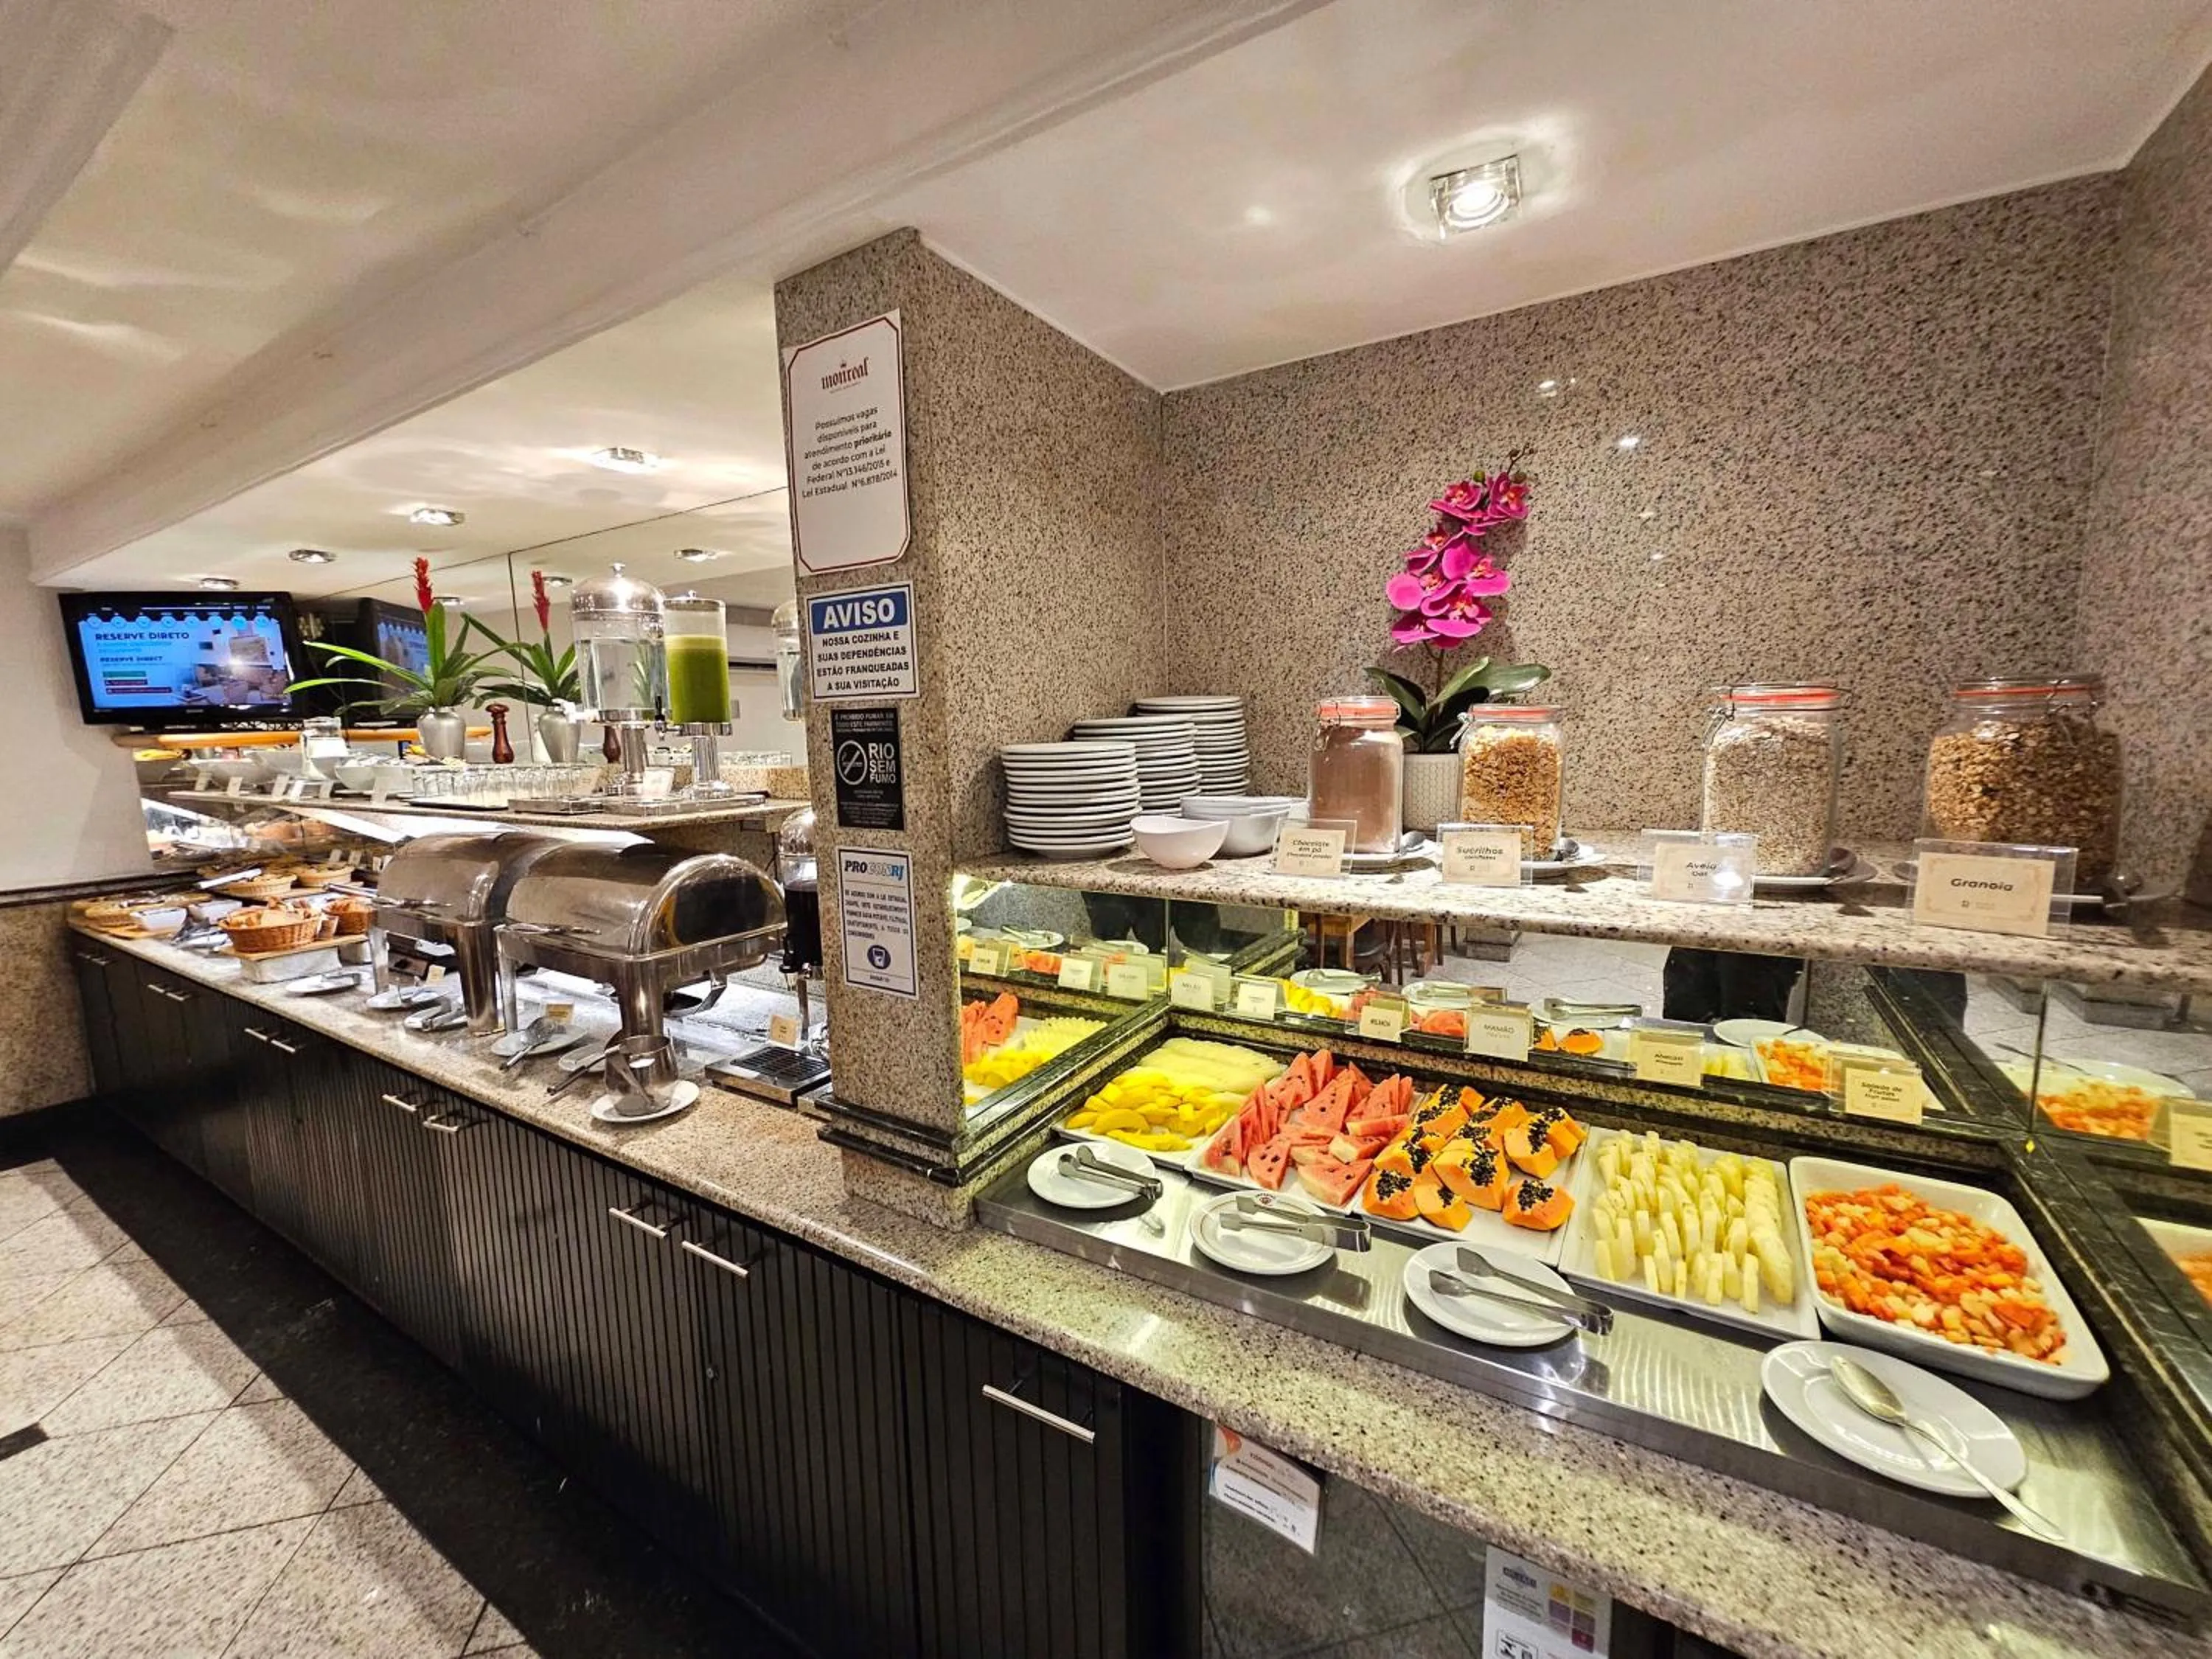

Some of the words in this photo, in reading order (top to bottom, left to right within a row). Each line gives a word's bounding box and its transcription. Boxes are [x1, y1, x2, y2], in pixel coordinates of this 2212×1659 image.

[856, 406, 877, 420] vagas
[860, 421, 877, 433] para
[804, 441, 853, 459] atendimento
[853, 429, 891, 450] prioritário
[812, 462, 822, 471] de
[823, 455, 849, 468] acordo
[851, 451, 867, 462] com
[875, 444, 886, 456] Lei
[807, 470, 835, 484] Federal
[886, 459, 890, 467] e
[802, 486, 813, 498] Lei
[815, 481, 847, 496] Estadual
[824, 598, 895, 629] AVISO
[95, 632, 145, 640] RESERVE
[822, 637, 849, 647] NOSSA
[852, 633, 891, 644] COZINHA
[893, 631, 900, 640] E
[818, 653, 838, 662] SUAS
[841, 646, 906, 660] DEPENDÊNCIAS
[817, 666, 843, 677] ESTÃO
[846, 662, 909, 675] FRANQUEADAS
[827, 682, 833, 691] A
[835, 681, 852, 691] SUA
[853, 677, 900, 689] VISITAÇÃO
[868, 742, 894, 759] RIO
[869, 760, 896, 773] SEM
[869, 774, 897, 784] FUMO
[1456, 846, 1503, 855] Sucrilhos
[1686, 862, 1717, 870] Aveia
[1950, 878, 2014, 891] Granola
